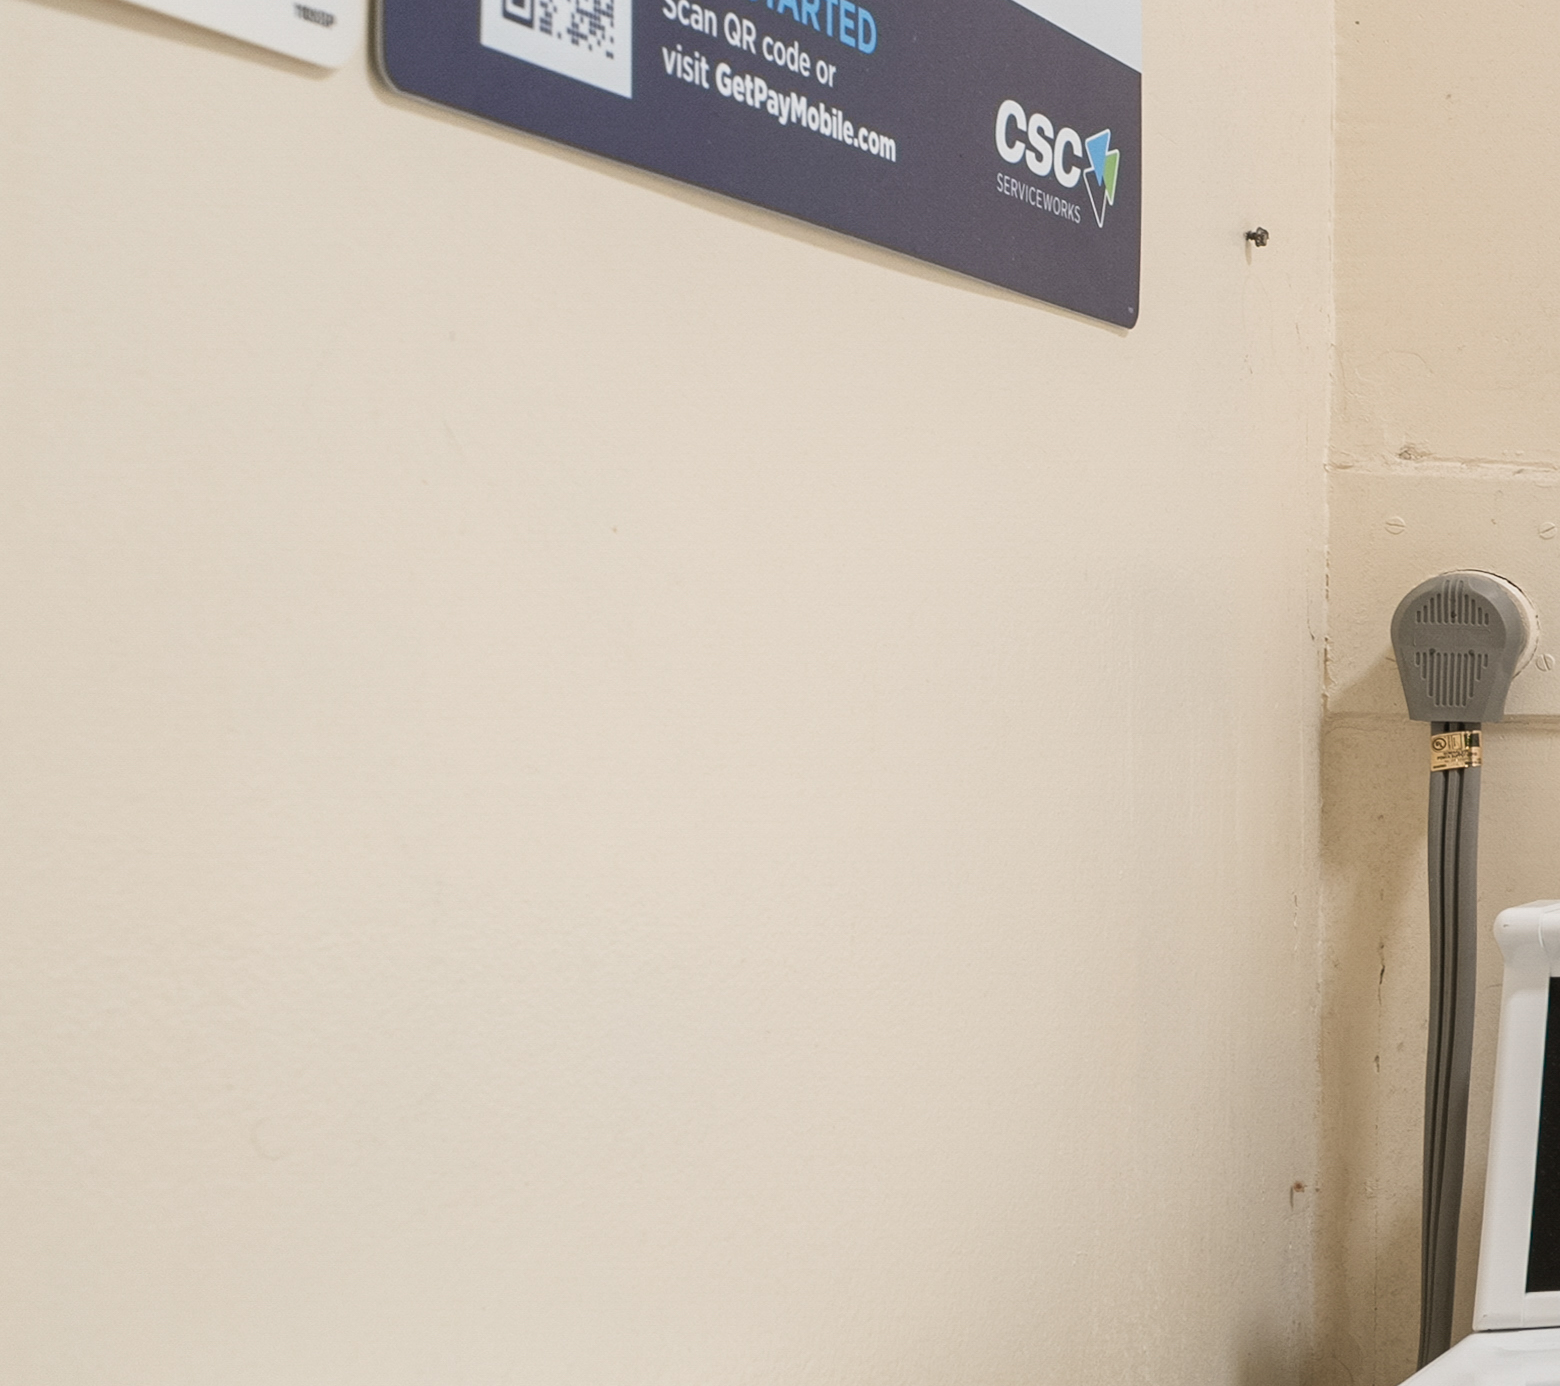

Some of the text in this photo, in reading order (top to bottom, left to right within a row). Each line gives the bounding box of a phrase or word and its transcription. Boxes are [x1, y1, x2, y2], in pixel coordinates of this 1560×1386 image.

[723, 12, 757, 55] QR
[762, 35, 811, 78] code
[815, 59, 837, 88] or
[662, 44, 897, 163] visit GetPayMobile.com
[995, 99, 1083, 188] CSC
[996, 172, 1081, 224] SERVICEWORKS
